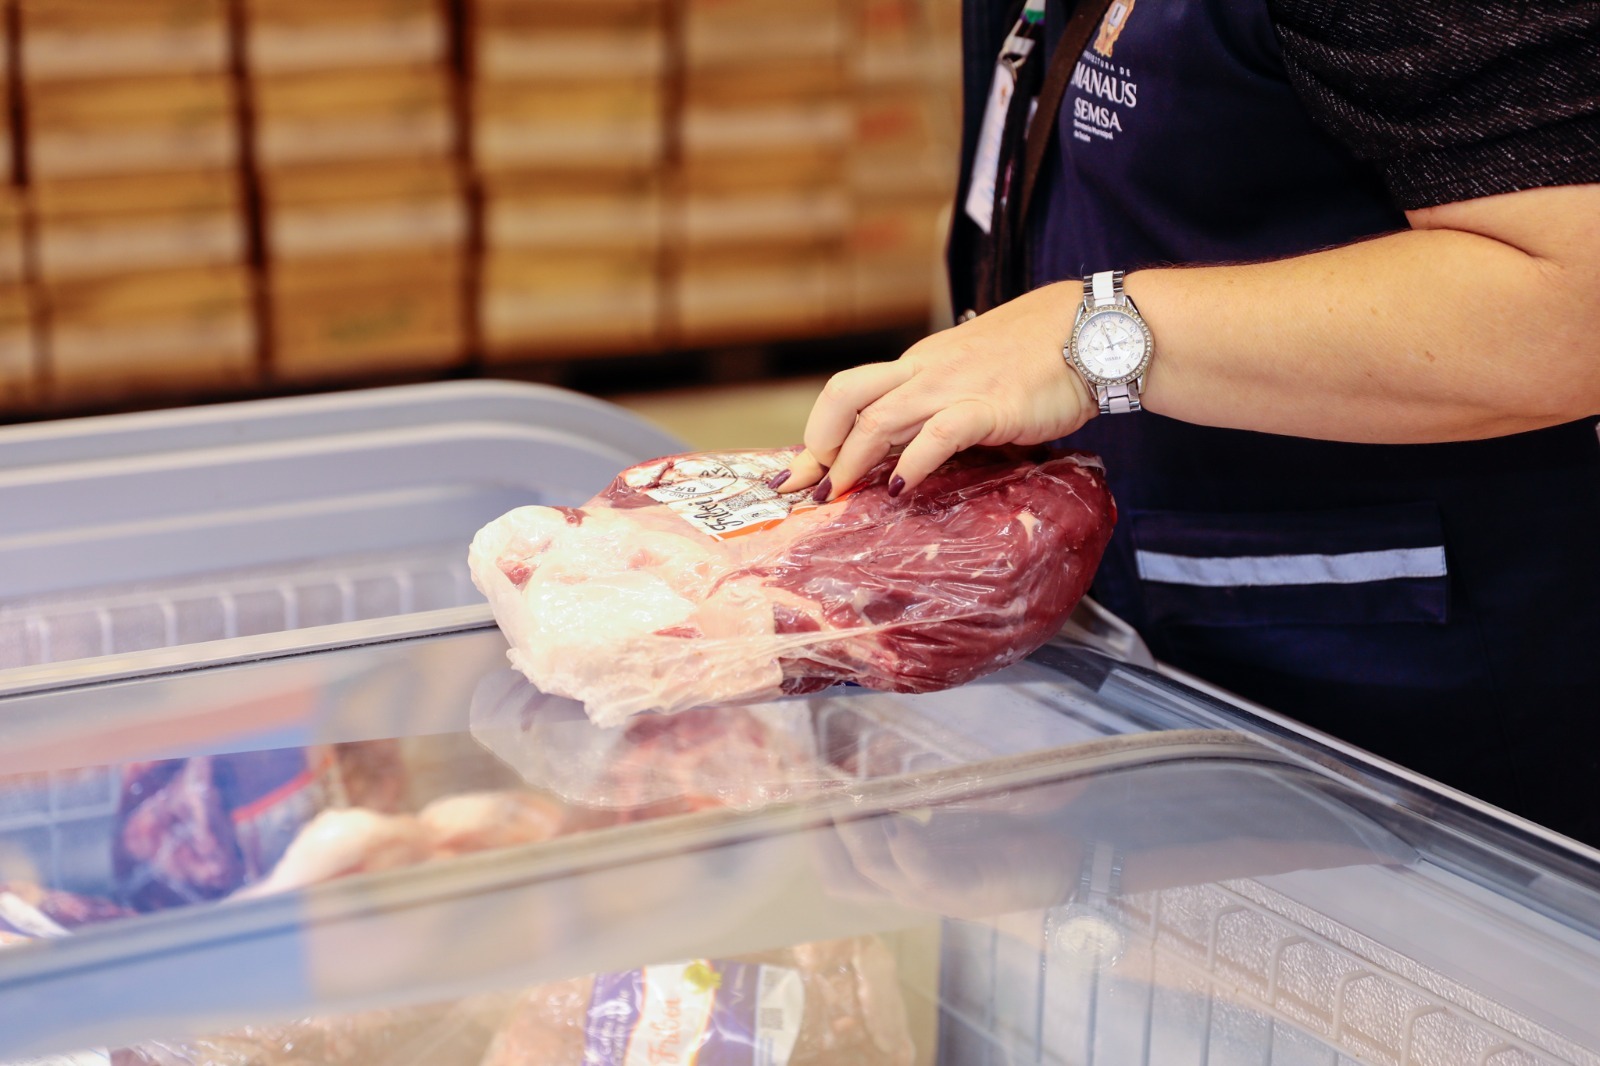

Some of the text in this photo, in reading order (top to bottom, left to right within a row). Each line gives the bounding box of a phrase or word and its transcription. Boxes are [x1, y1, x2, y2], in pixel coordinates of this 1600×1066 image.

[1071, 61, 1137, 108] MANAUS
[1119, 66, 1131, 77] DE
[1073, 96, 1122, 132] SEMSA
